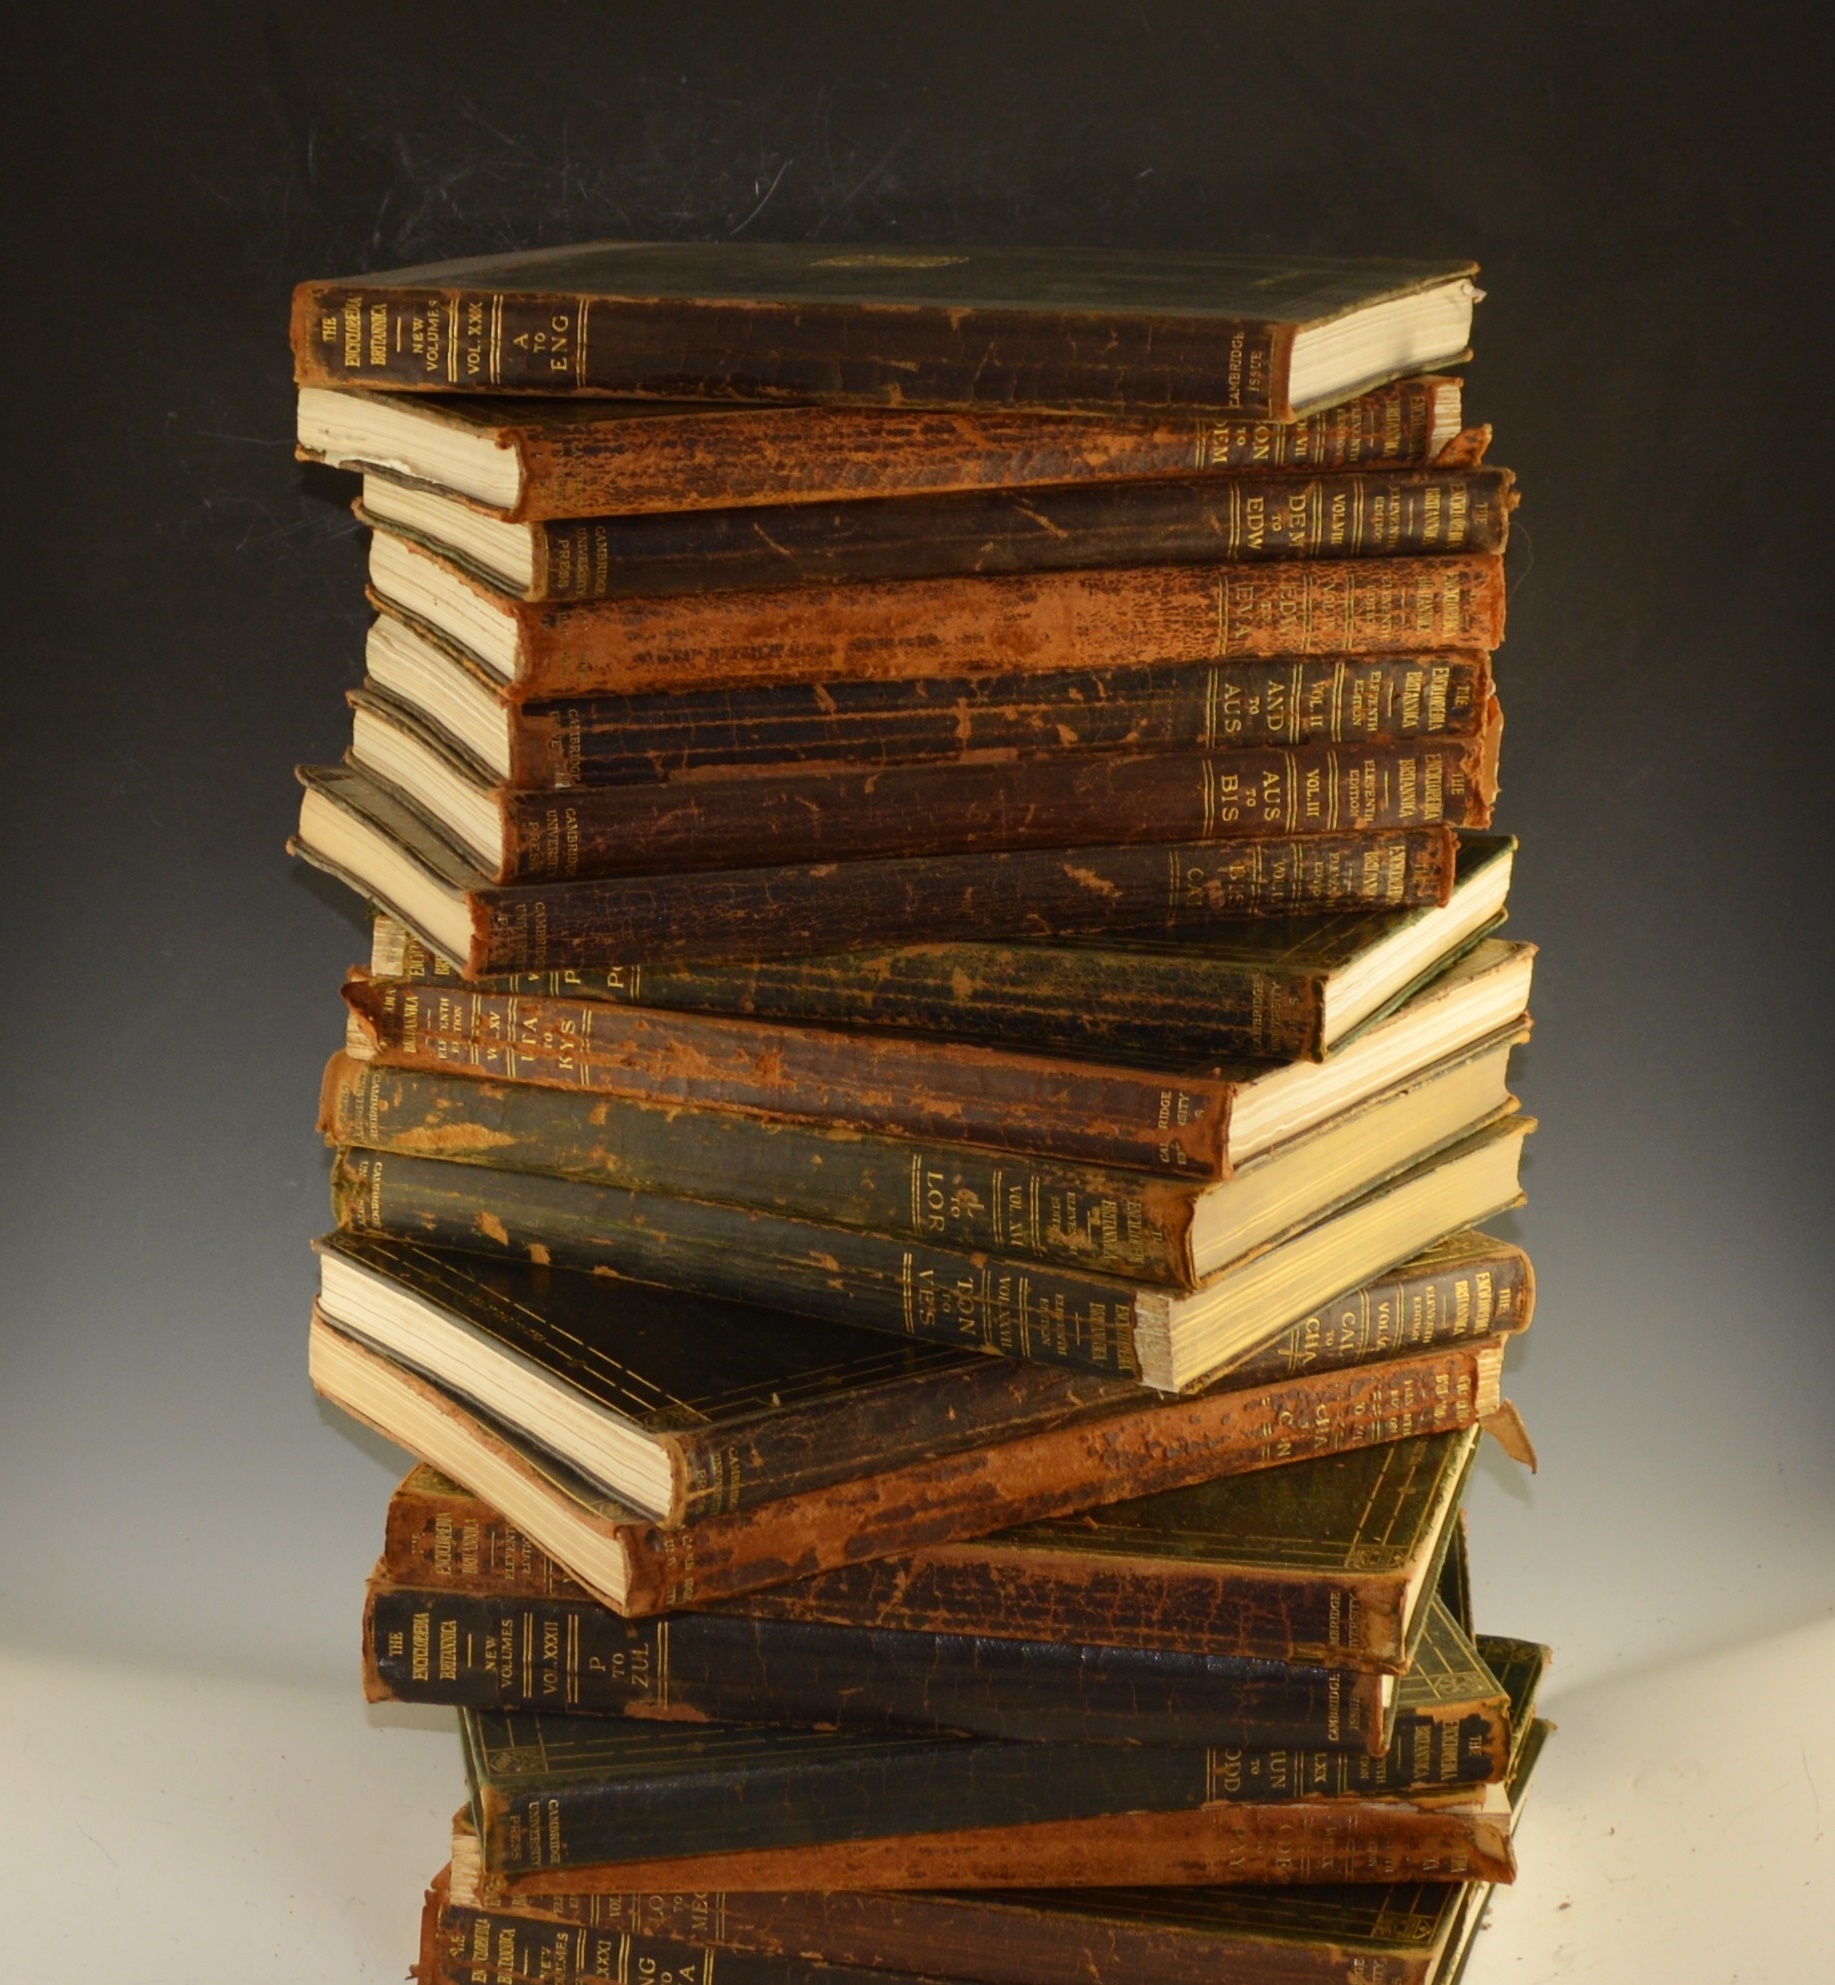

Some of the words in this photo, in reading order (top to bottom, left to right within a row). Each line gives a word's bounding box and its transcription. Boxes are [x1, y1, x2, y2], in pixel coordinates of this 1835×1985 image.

[322, 317, 337, 343] THE
[370, 304, 388, 367] BRITANNICA
[412, 317, 424, 354] NEW
[426, 300, 440, 372] VOLUMES
[513, 333, 529, 350] A
[533, 332, 546, 354] TO
[551, 314, 569, 371] ENG
[1247, 496, 1264, 550] EDW
[1271, 514, 1282, 533] TO
[1288, 494, 1307, 548] DEM
[1223, 683, 1242, 733] AUS
[1250, 696, 1260, 715] TO
[1266, 681, 1285, 731] AND
[1403, 671, 1423, 728] BRITANNICA
[1220, 773, 1239, 822] BIS
[1246, 787, 1256, 807] TO
[1263, 770, 1281, 821] AUS
[1399, 758, 1416, 818] BRITANNICA
[927, 1171, 945, 1232] LOR
[919, 1269, 936, 1326] VES
[956, 1277, 977, 1336] TON
[1303, 1317, 1321, 1364] CHA
[1340, 1311, 1356, 1356] CAL
[389, 1632, 403, 1657] THE
[440, 1620, 457, 1681] BRITANNICA
[485, 1635, 498, 1671] NEW
[501, 1618, 514, 1689] VOLUMES
[590, 1656, 606, 1672] P
[612, 1653, 626, 1679] TO
[632, 1643, 649, 1688] ZUL
[1251, 1759, 1260, 1775] TO
[1469, 1735, 1482, 1757] THE
[1270, 1751, 1287, 1789] UN
